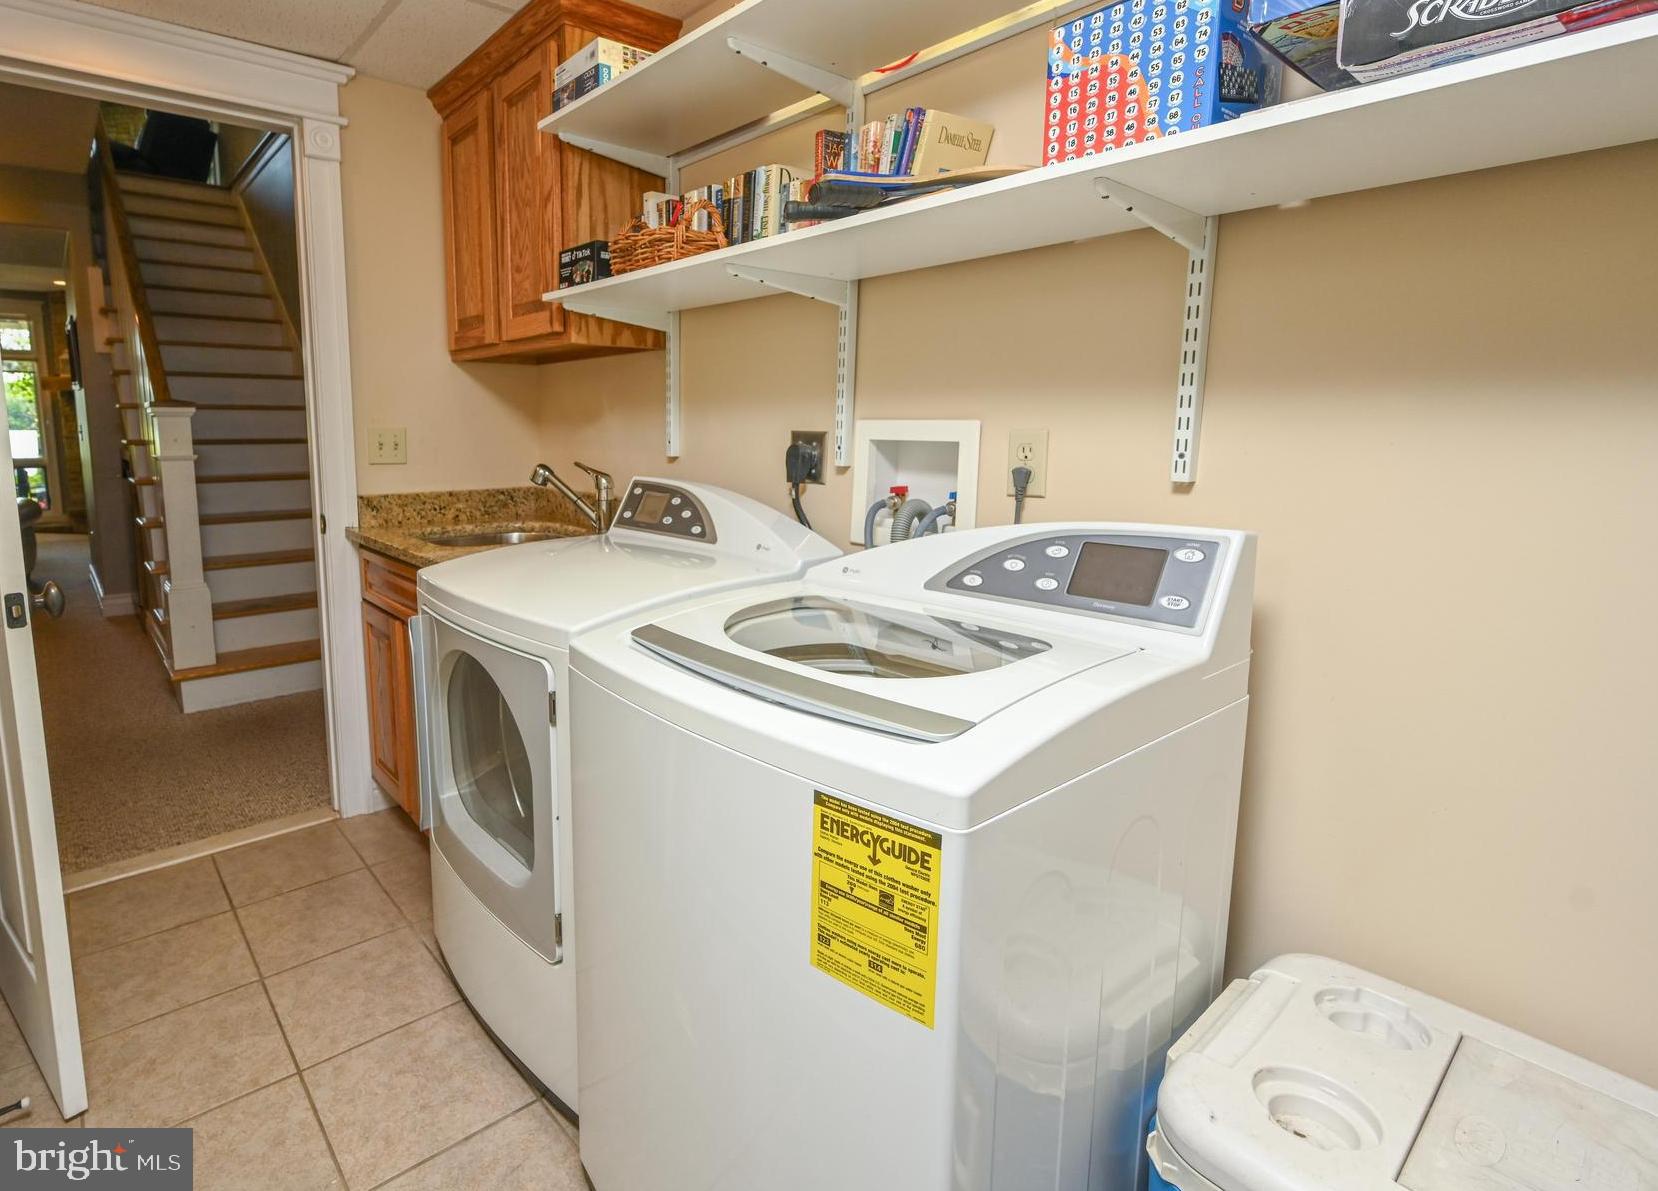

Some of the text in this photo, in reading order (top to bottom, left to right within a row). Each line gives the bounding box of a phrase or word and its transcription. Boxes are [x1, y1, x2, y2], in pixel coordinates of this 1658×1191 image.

[1177, 0, 1187, 10] 62
[1113, 7, 1121, 17] 31
[1154, 8, 1164, 18] 52
[1199, 11, 1209, 21] 73
[1093, 15, 1101, 24] 21
[1132, 16, 1142, 25] 42
[1175, 19, 1185, 29] 63
[1074, 23, 1081, 31] 11
[1112, 24, 1121, 34] 32
[1092, 32, 1100, 41] 22
[1153, 27, 1162, 37] 53
[1198, 29, 1208, 39] 74
[1073, 38, 1081, 47] 12
[1131, 35, 1140, 43] 43
[1174, 37, 1184, 46] 64
[1111, 42, 1119, 51] 33
[1152, 44, 1161, 54] 54
[1091, 49, 1099, 59] 23
[1130, 52, 1140, 61] 44
[1197, 47, 1206, 57] 75
[1072, 56, 1080, 65] 13
[1111, 59, 1119, 68] 34
[1173, 55, 1182, 65] 65
[1090, 66, 1098, 75] 24
[1151, 62, 1160, 72] 55
[1071, 72, 1080, 80] 14
[1129, 69, 1138, 78] 45
[1109, 76, 1117, 85] 35
[1171, 74, 1181, 84] 66
[1089, 82, 1097, 92] 25
[1148, 81, 1159, 91] 56
[1070, 88, 1078, 97] 15
[1127, 88, 1137, 96] 46
[1108, 94, 1116, 103] 36
[1170, 92, 1180, 102] 67
[1088, 100, 1097, 110] 26
[1148, 99, 1157, 108] 57
[1069, 106, 1078, 114] 16
[1107, 111, 1115, 120] 37
[1169, 111, 1179, 120] 68
[1087, 117, 1095, 126] 27
[1147, 117, 1156, 126] 58
[1069, 122, 1076, 131] 17
[1125, 123, 1135, 131] 48
[1106, 128, 1114, 137] 38
[938, 126, 982, 153] DANIELLE STEEL
[1086, 134, 1094, 143] 28
[1067, 139, 1076, 148] 18
